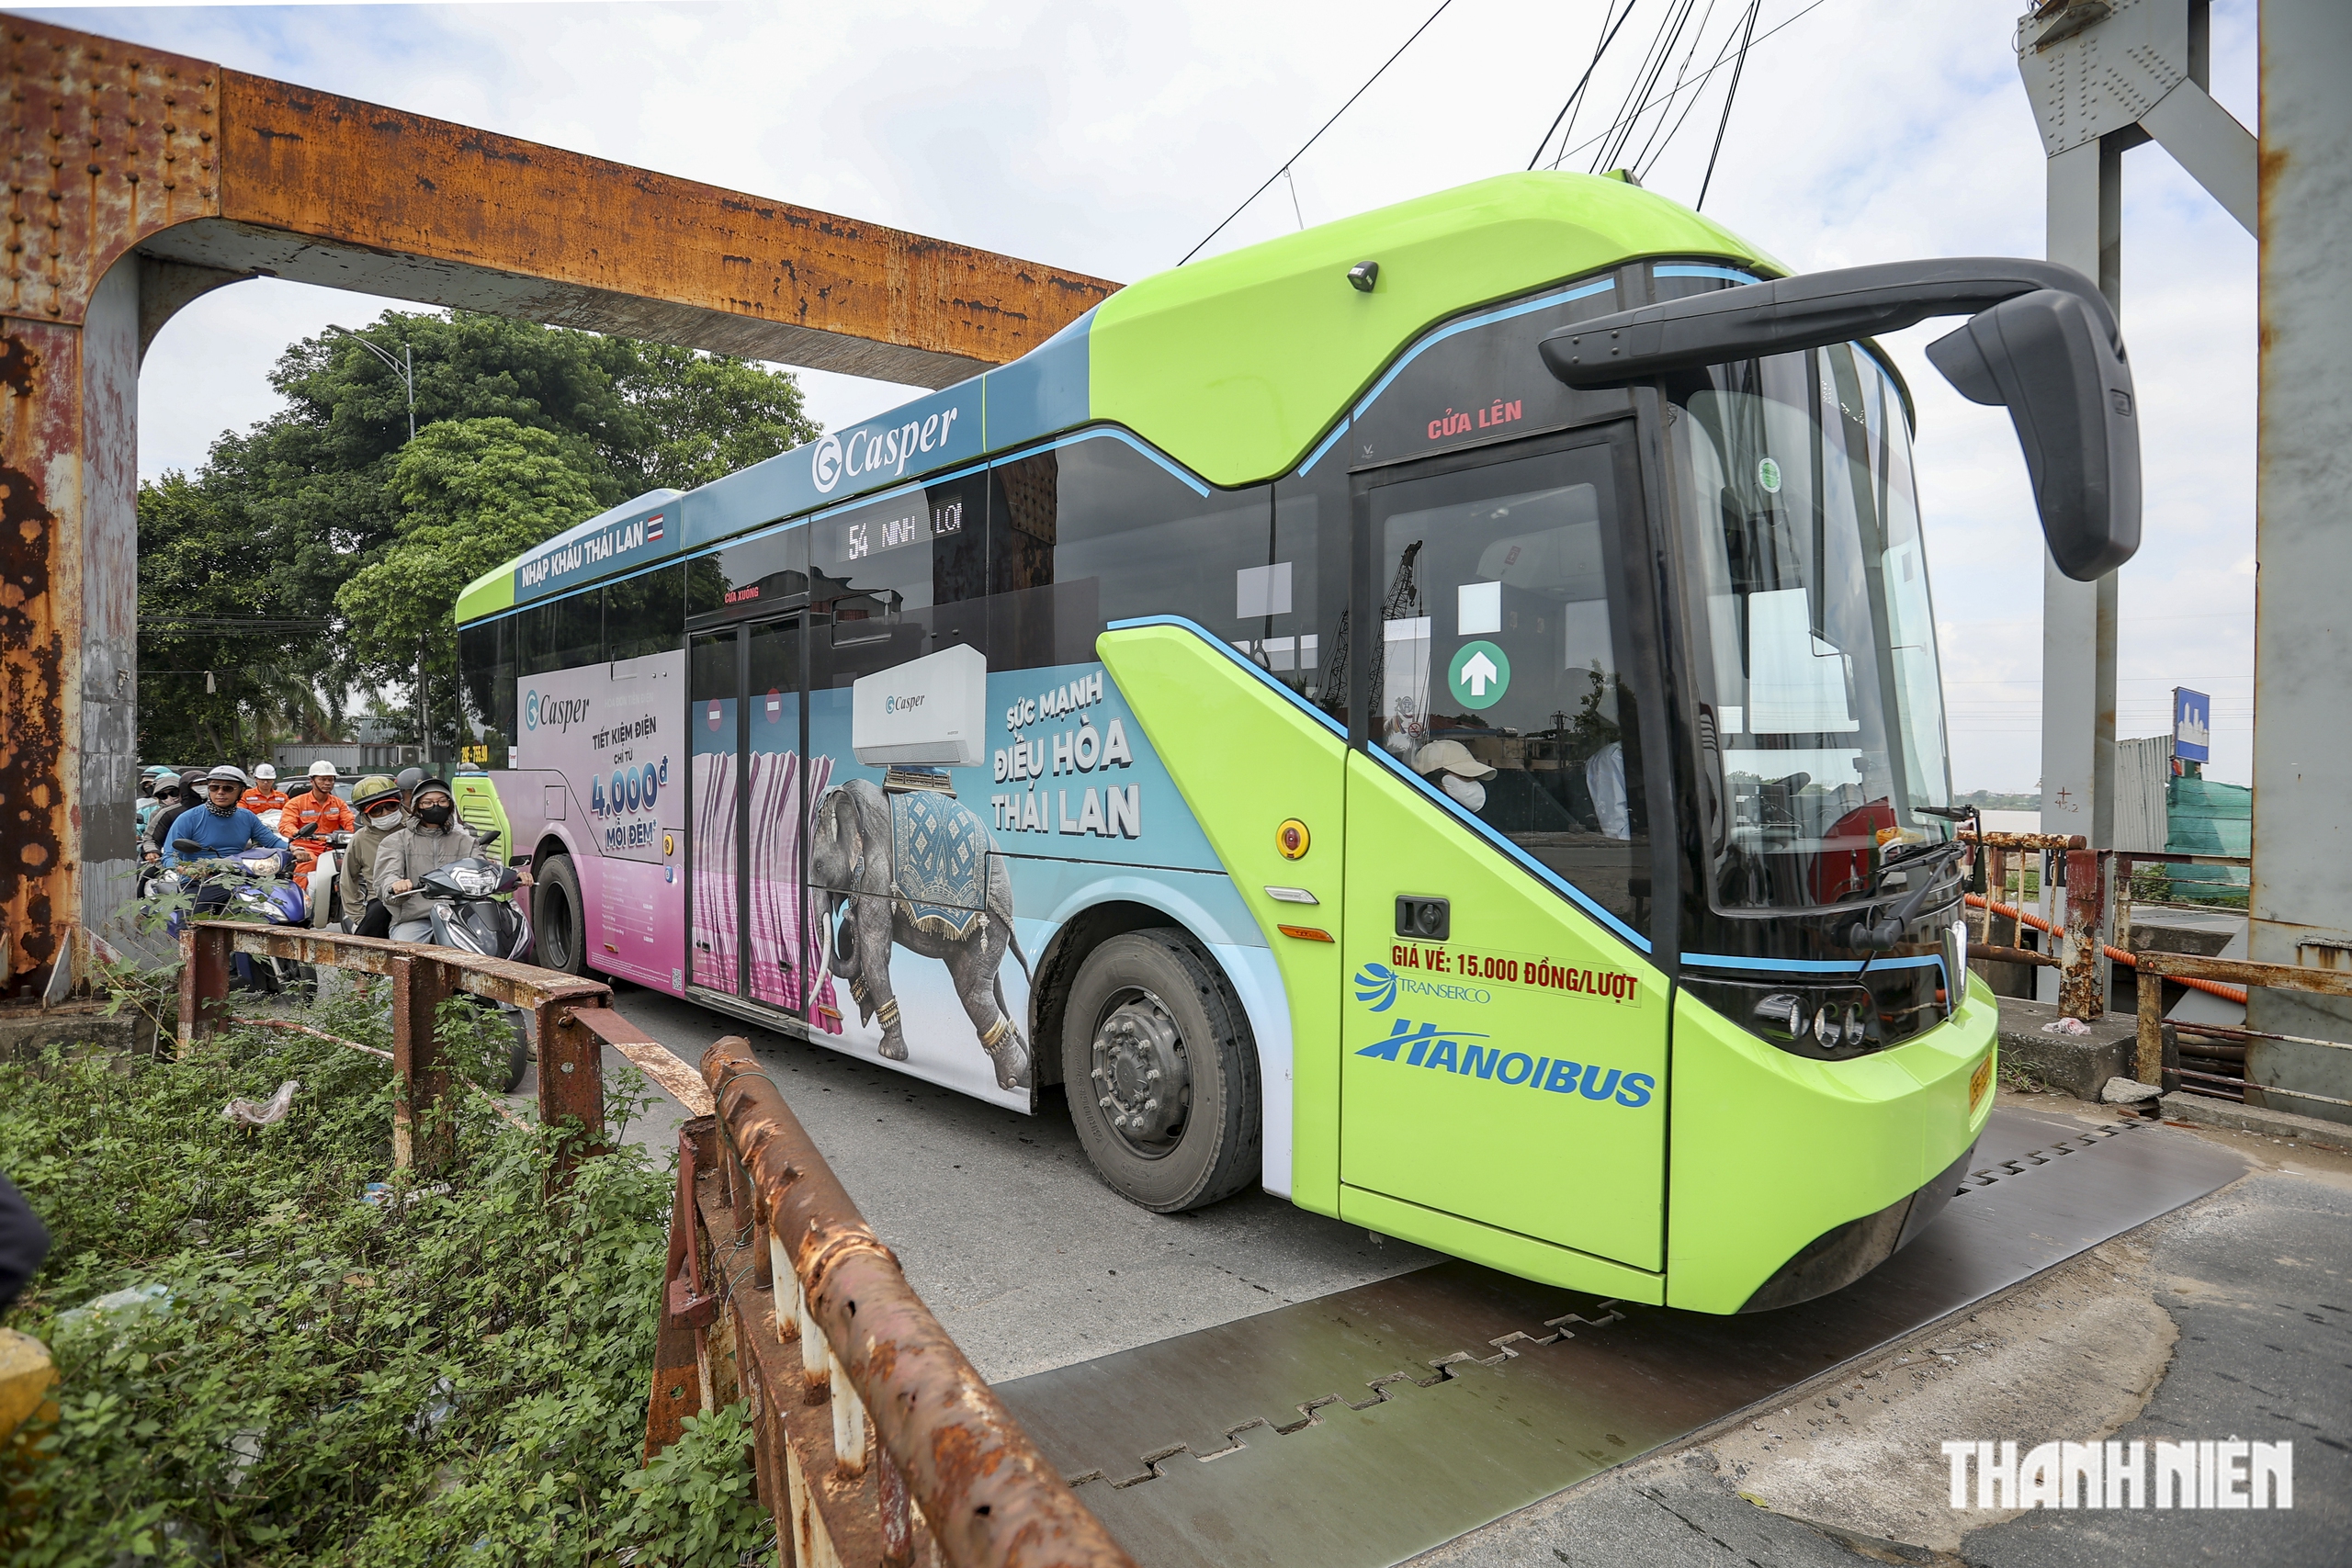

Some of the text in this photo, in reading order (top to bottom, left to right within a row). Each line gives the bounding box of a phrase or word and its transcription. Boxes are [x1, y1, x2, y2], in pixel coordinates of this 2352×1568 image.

[845, 407, 957, 476] Casper
[1427, 398, 1522, 440] CỬA LÊN
[522, 520, 643, 588] NHẬP KHẨU THÁI LAN
[849, 522, 868, 560] 54
[539, 694, 590, 734] Casper
[895, 695, 925, 712] Casper
[1006, 670, 1102, 733] SỨC MẠNH
[592, 714, 657, 750] TIẾT KIỆM ĐIỆN
[993, 712, 1134, 784] ĐIỀU HÒA
[606, 818, 627, 849] MỖI
[990, 778, 1141, 840] THÁI LAN
[1392, 943, 1638, 1004] GIÁ VÉ: 15.000 ĐỒNG/LƯỢT
[1397, 977, 1491, 1004] TRANSERCO
[1353, 1017, 1657, 1108] HANOIBUS
